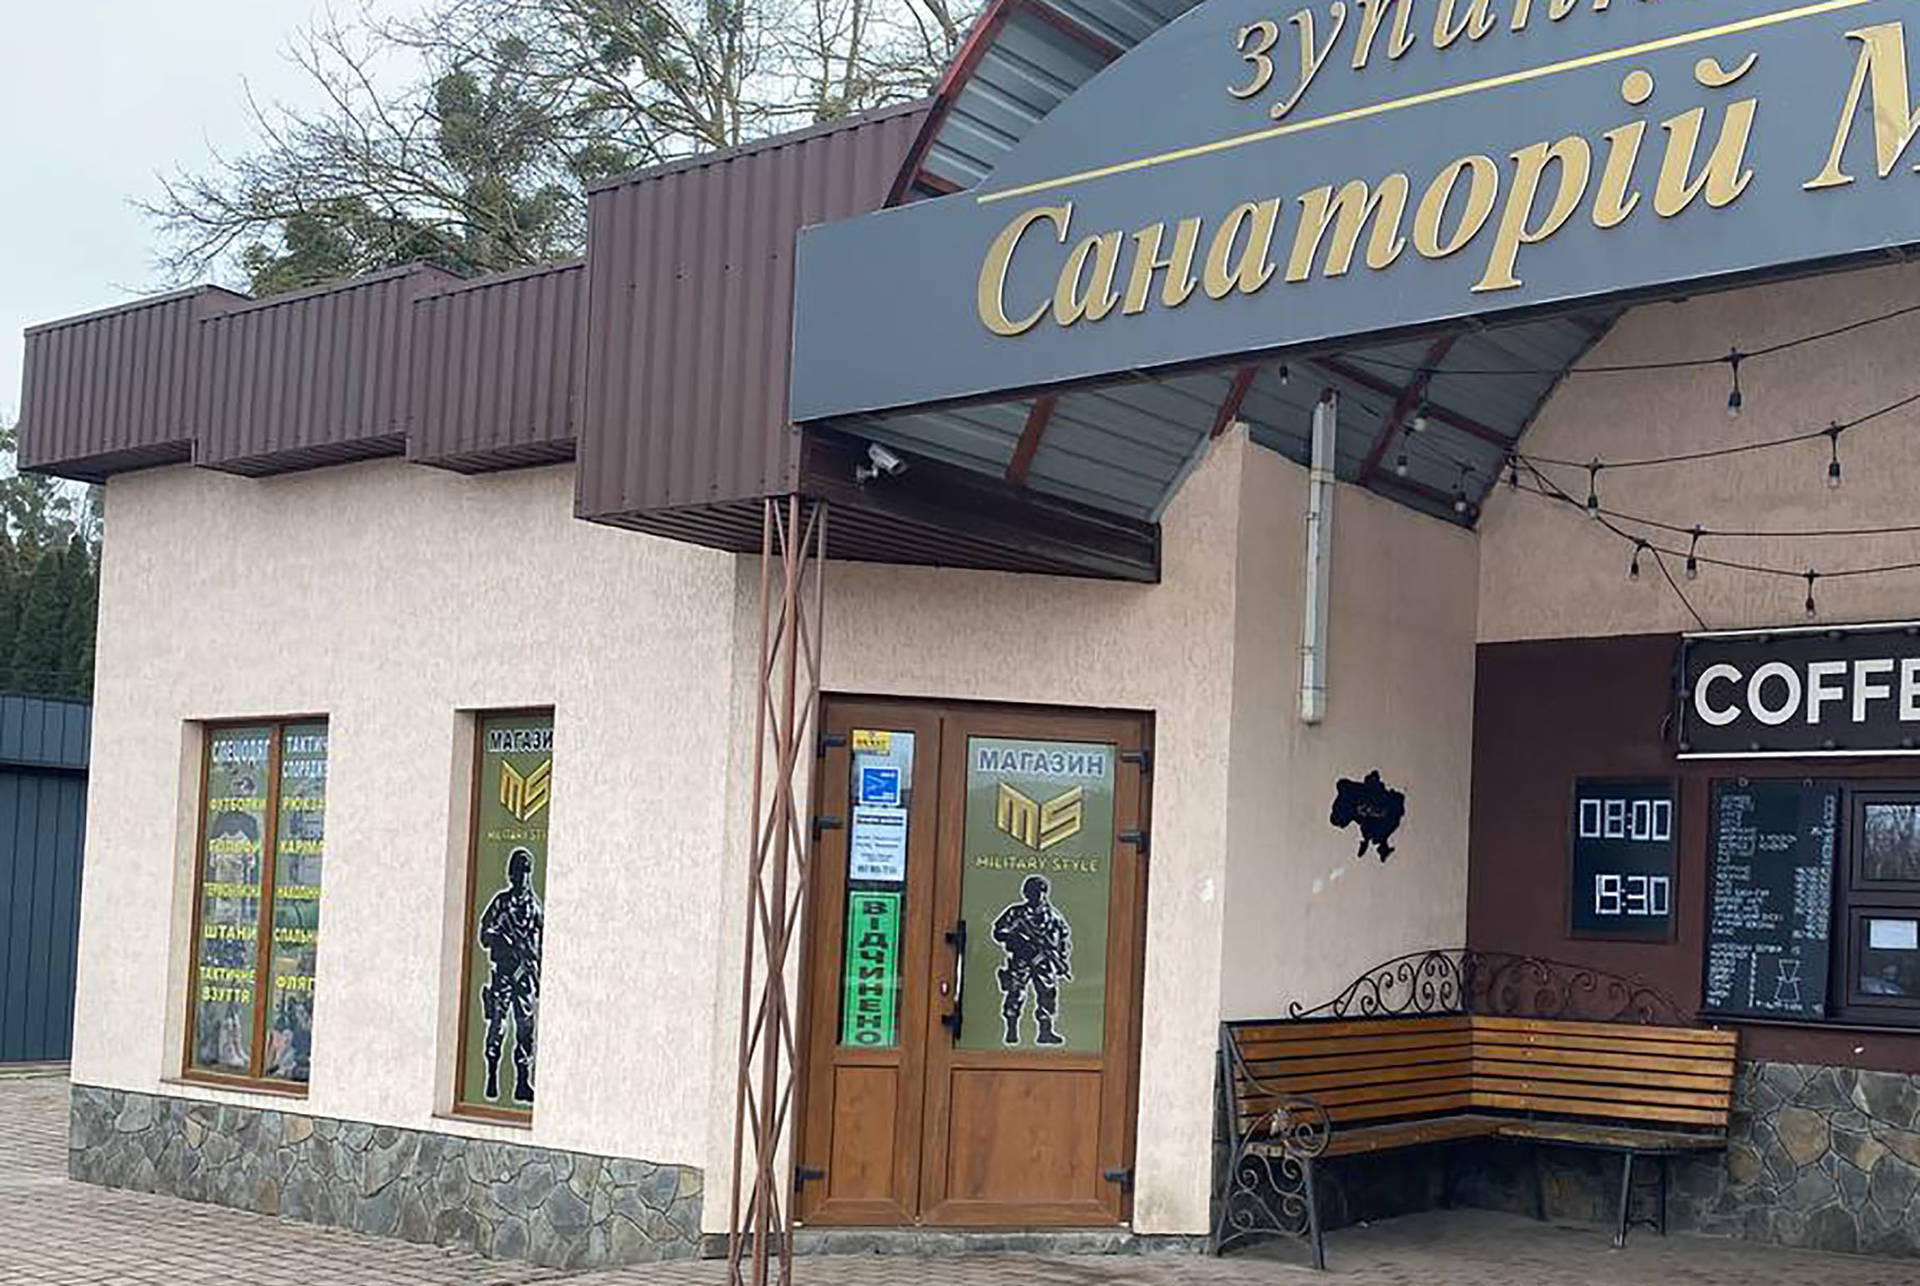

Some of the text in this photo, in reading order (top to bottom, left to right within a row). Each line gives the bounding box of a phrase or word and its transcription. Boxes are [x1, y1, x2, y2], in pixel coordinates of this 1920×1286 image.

[1227, 0, 1658, 118] зупи
[976, 52, 1758, 336] Санаторій
[977, 748, 1105, 777] МАГАЗИН
[1580, 799, 1671, 841] 08:00
[975, 855, 1100, 873] MILITARY STYLE
[1595, 874, 1670, 915] 19:30
[204, 924, 258, 940] ШТАНИ
[855, 901, 888, 1045] ВІДЧИНЕНО
[201, 986, 251, 1004] ВЗУТТЯ
